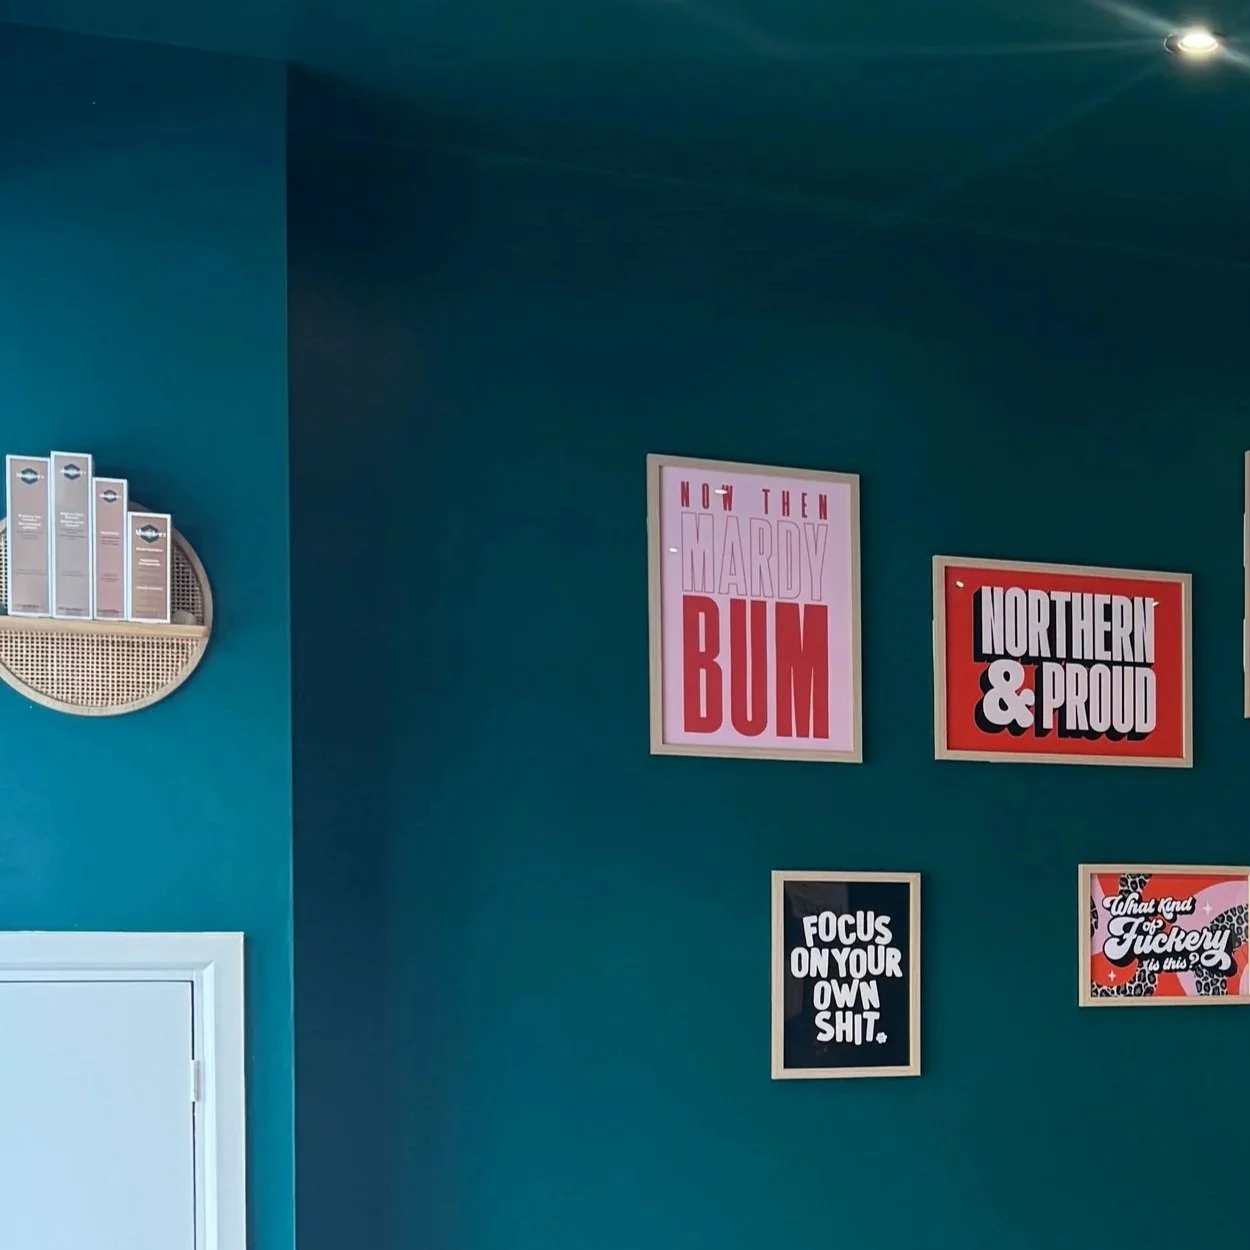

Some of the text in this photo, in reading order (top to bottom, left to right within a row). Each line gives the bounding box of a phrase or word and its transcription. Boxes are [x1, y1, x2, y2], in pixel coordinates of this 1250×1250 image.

[680, 480, 828, 520] NOW THEN
[680, 511, 828, 601] MARDY
[979, 585, 1156, 664] NORTHERN
[682, 594, 829, 739] BUM
[980, 659, 1157, 735] & PROUD
[1102, 892, 1156, 916] What
[802, 910, 893, 948] FOCUS
[1104, 916, 1232, 971] Fuckery
[1142, 918, 1164, 934] of
[790, 944, 903, 979] ON YOUR
[1149, 953, 1200, 972] is this?
[813, 978, 881, 1011] OWN
